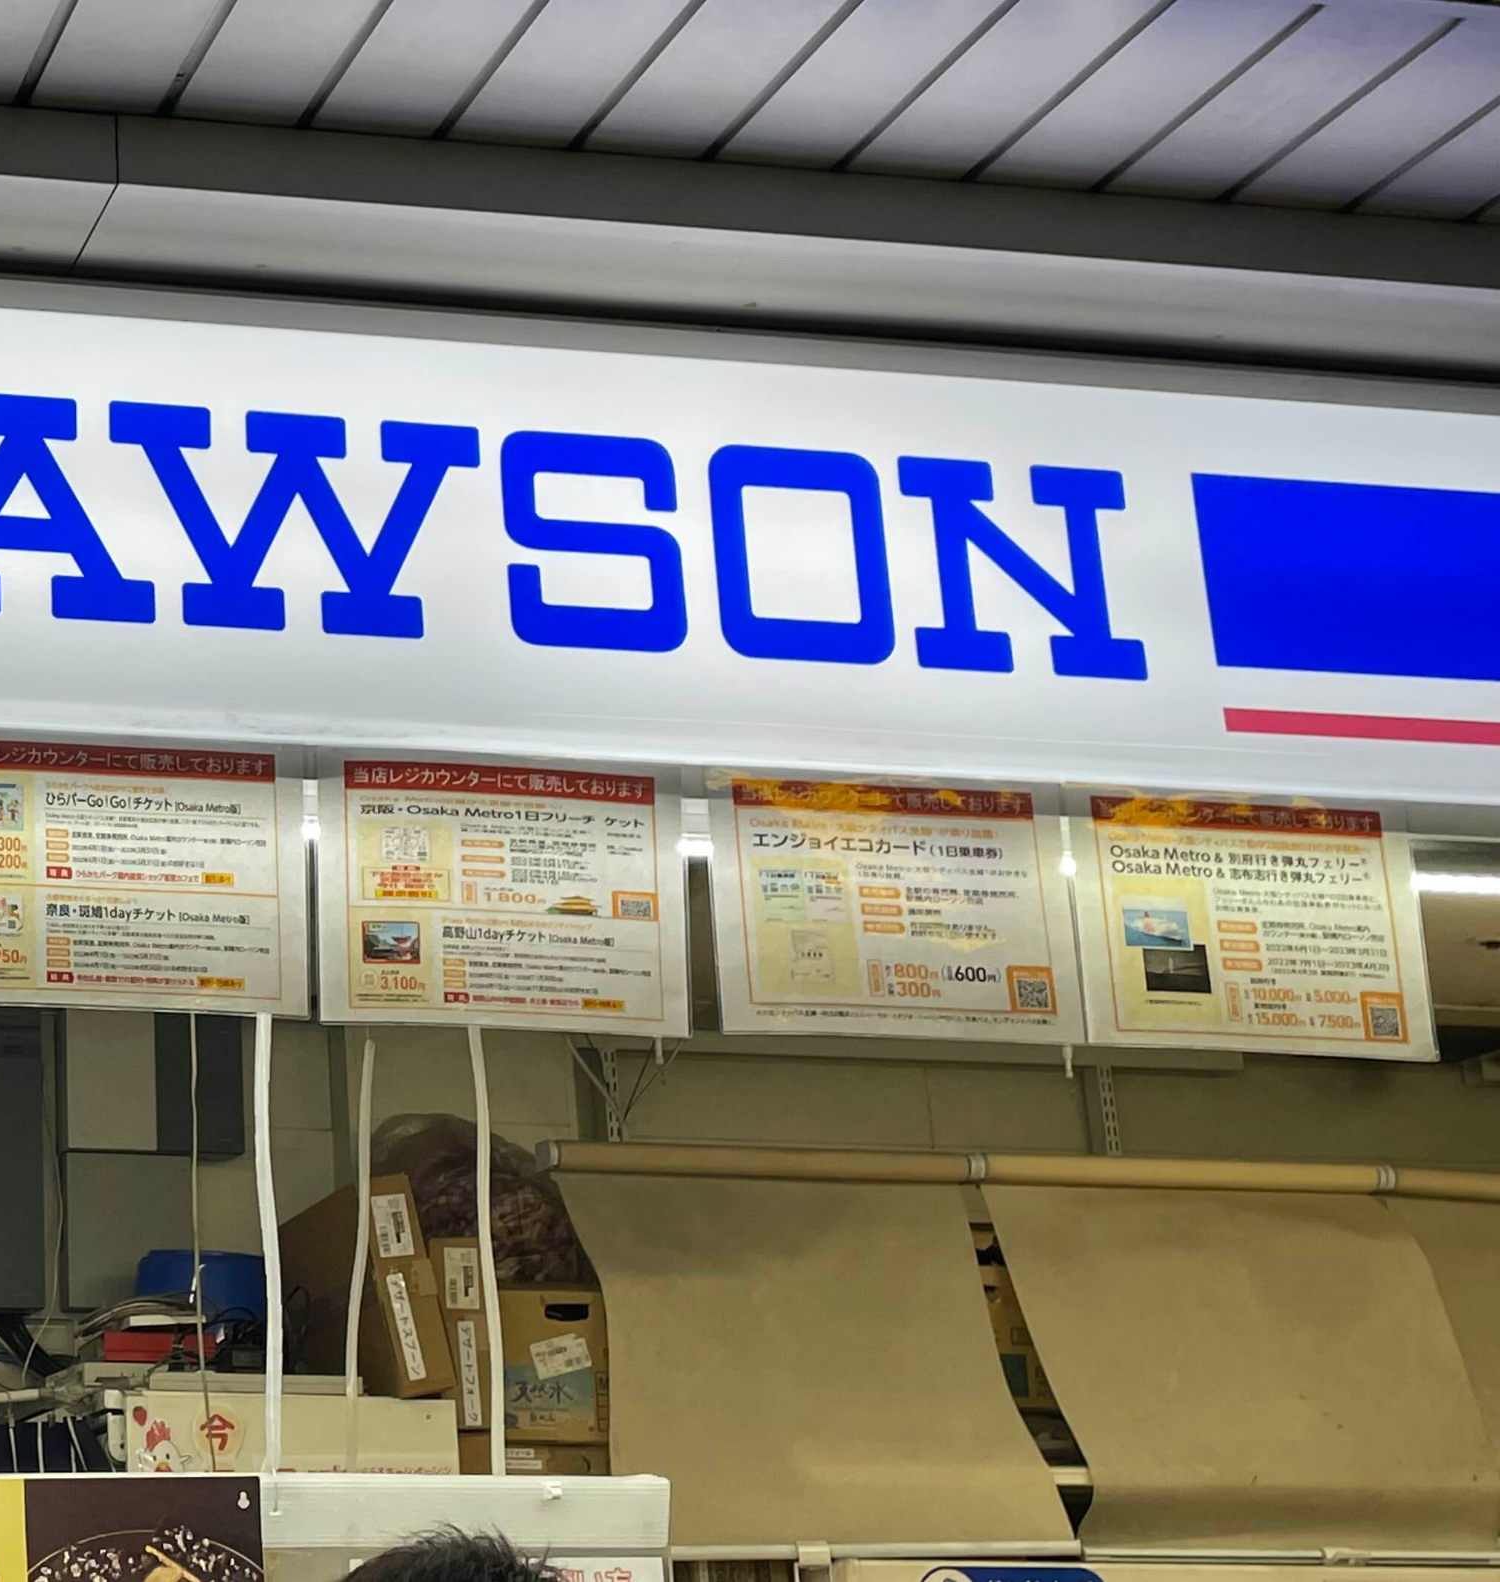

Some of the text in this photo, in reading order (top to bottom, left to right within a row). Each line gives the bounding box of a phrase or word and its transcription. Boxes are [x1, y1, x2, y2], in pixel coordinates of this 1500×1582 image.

[353, 766, 647, 799] 当店レジカウンターにて販売しております
[1110, 845, 1160, 860] Osaka
[1164, 847, 1211, 863] Metro
[1112, 861, 1162, 876] Osaka
[1166, 863, 1213, 879] Metro
[200, 1413, 235, 1452] 今
